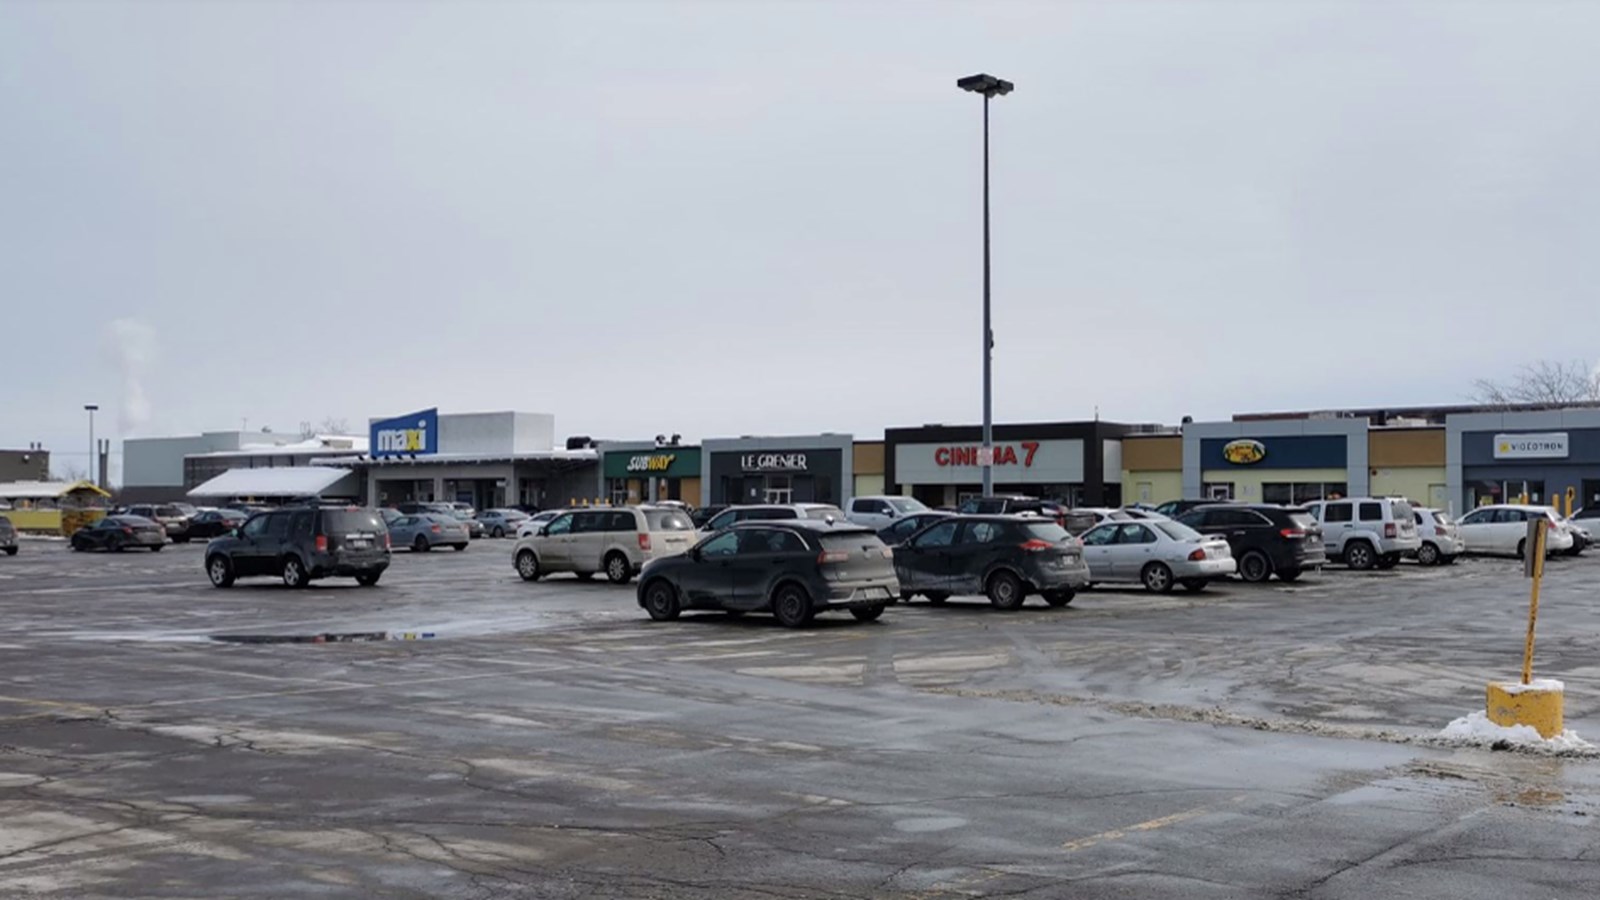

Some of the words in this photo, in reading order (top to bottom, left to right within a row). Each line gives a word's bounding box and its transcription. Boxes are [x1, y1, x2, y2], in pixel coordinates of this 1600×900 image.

[377, 419, 427, 452] maxi
[626, 454, 675, 471] SUBWAY
[741, 454, 755, 469] LE
[756, 453, 807, 470] GRENIER
[1021, 441, 1040, 468] 7
